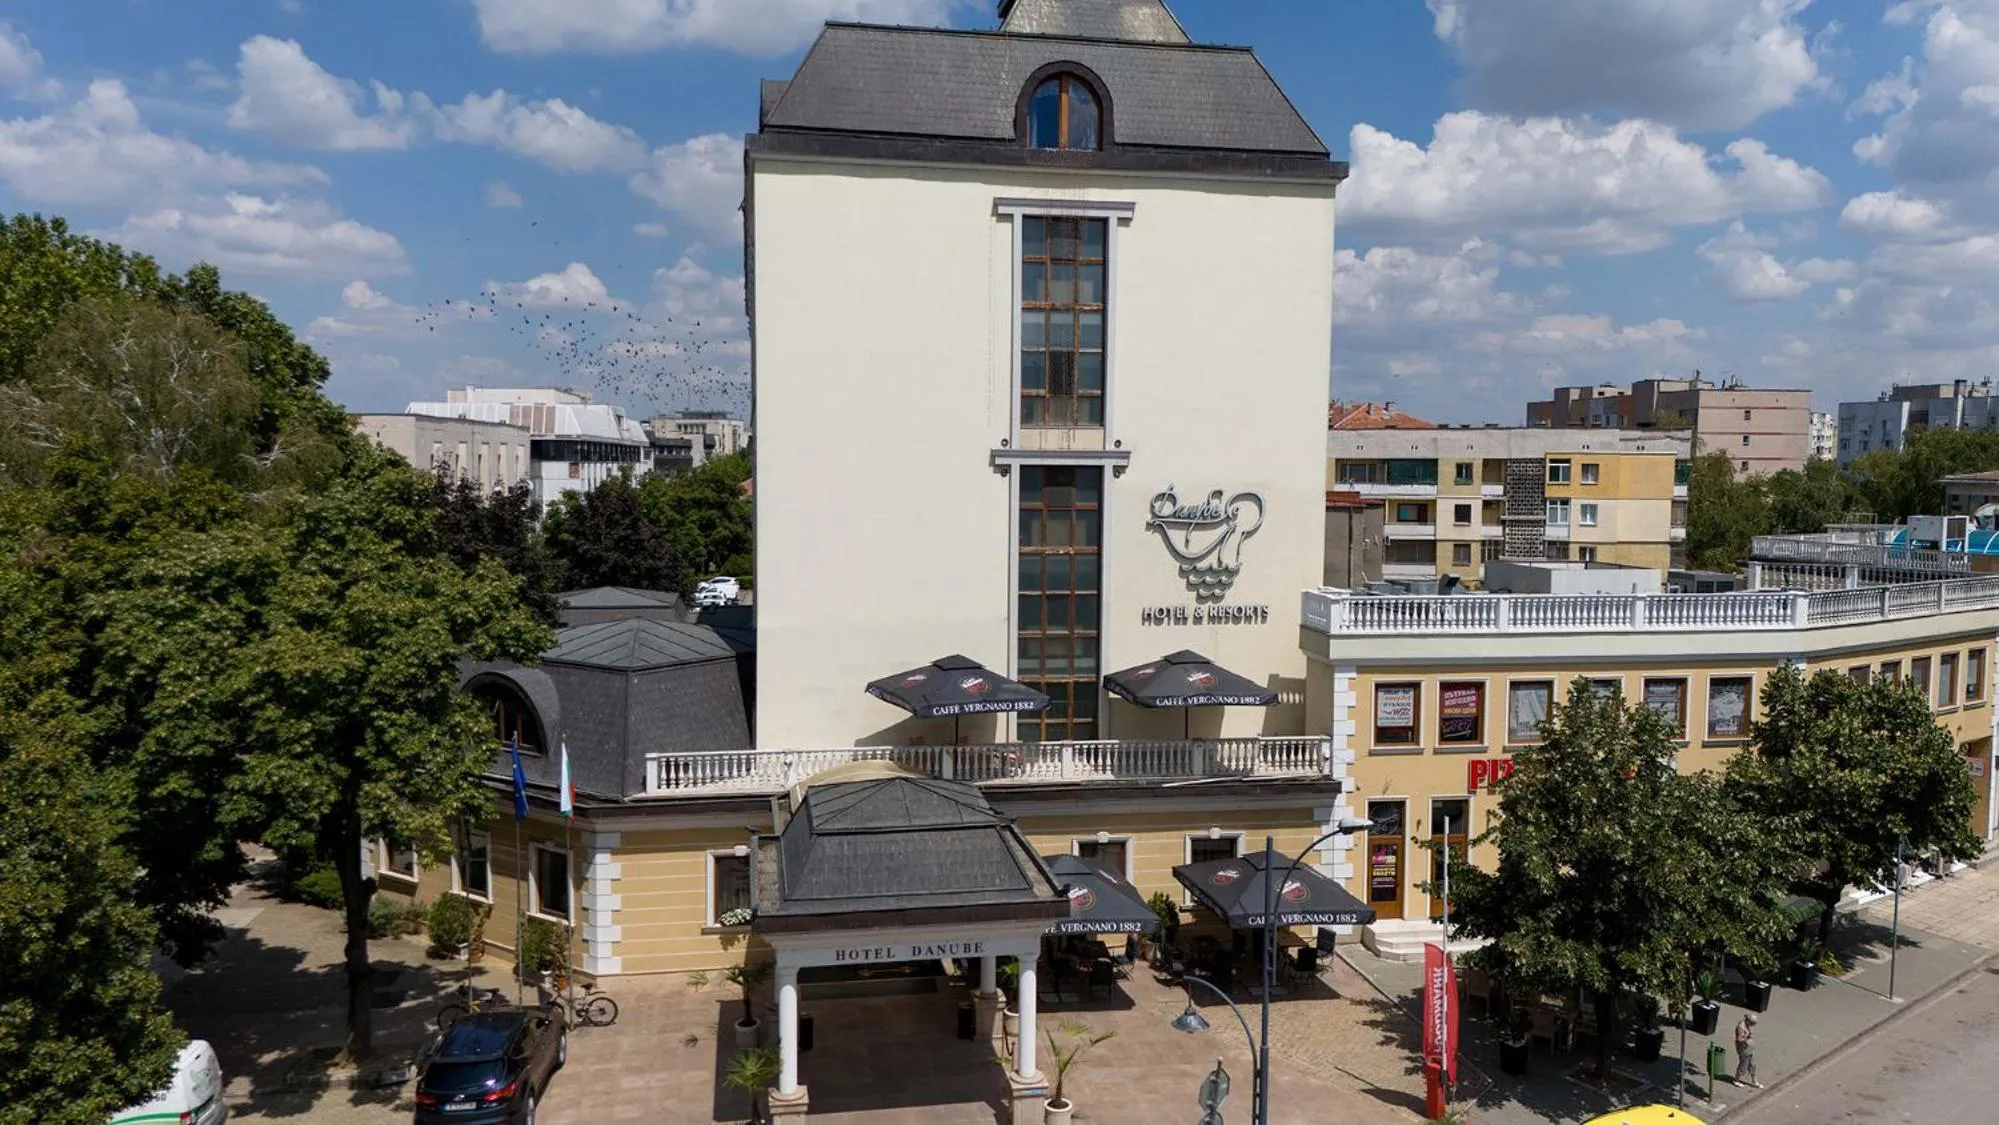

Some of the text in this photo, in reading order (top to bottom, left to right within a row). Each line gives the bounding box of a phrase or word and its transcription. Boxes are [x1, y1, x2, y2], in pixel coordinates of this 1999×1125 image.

[1144, 605, 1269, 620] HOTEL & RESORTS
[1187, 695, 1238, 705] VERGNANO
[1240, 695, 1261, 705] 1882
[964, 702, 1012, 713] VERGNANO
[1014, 701, 1034, 710] 1882
[1281, 914, 1333, 924] VERGNANO
[1335, 913, 1358, 923] 1882
[1061, 922, 1117, 932] VERGNANO
[1119, 921, 1142, 931] 1882
[836, 942, 983, 961] HOTEL DANUBE
